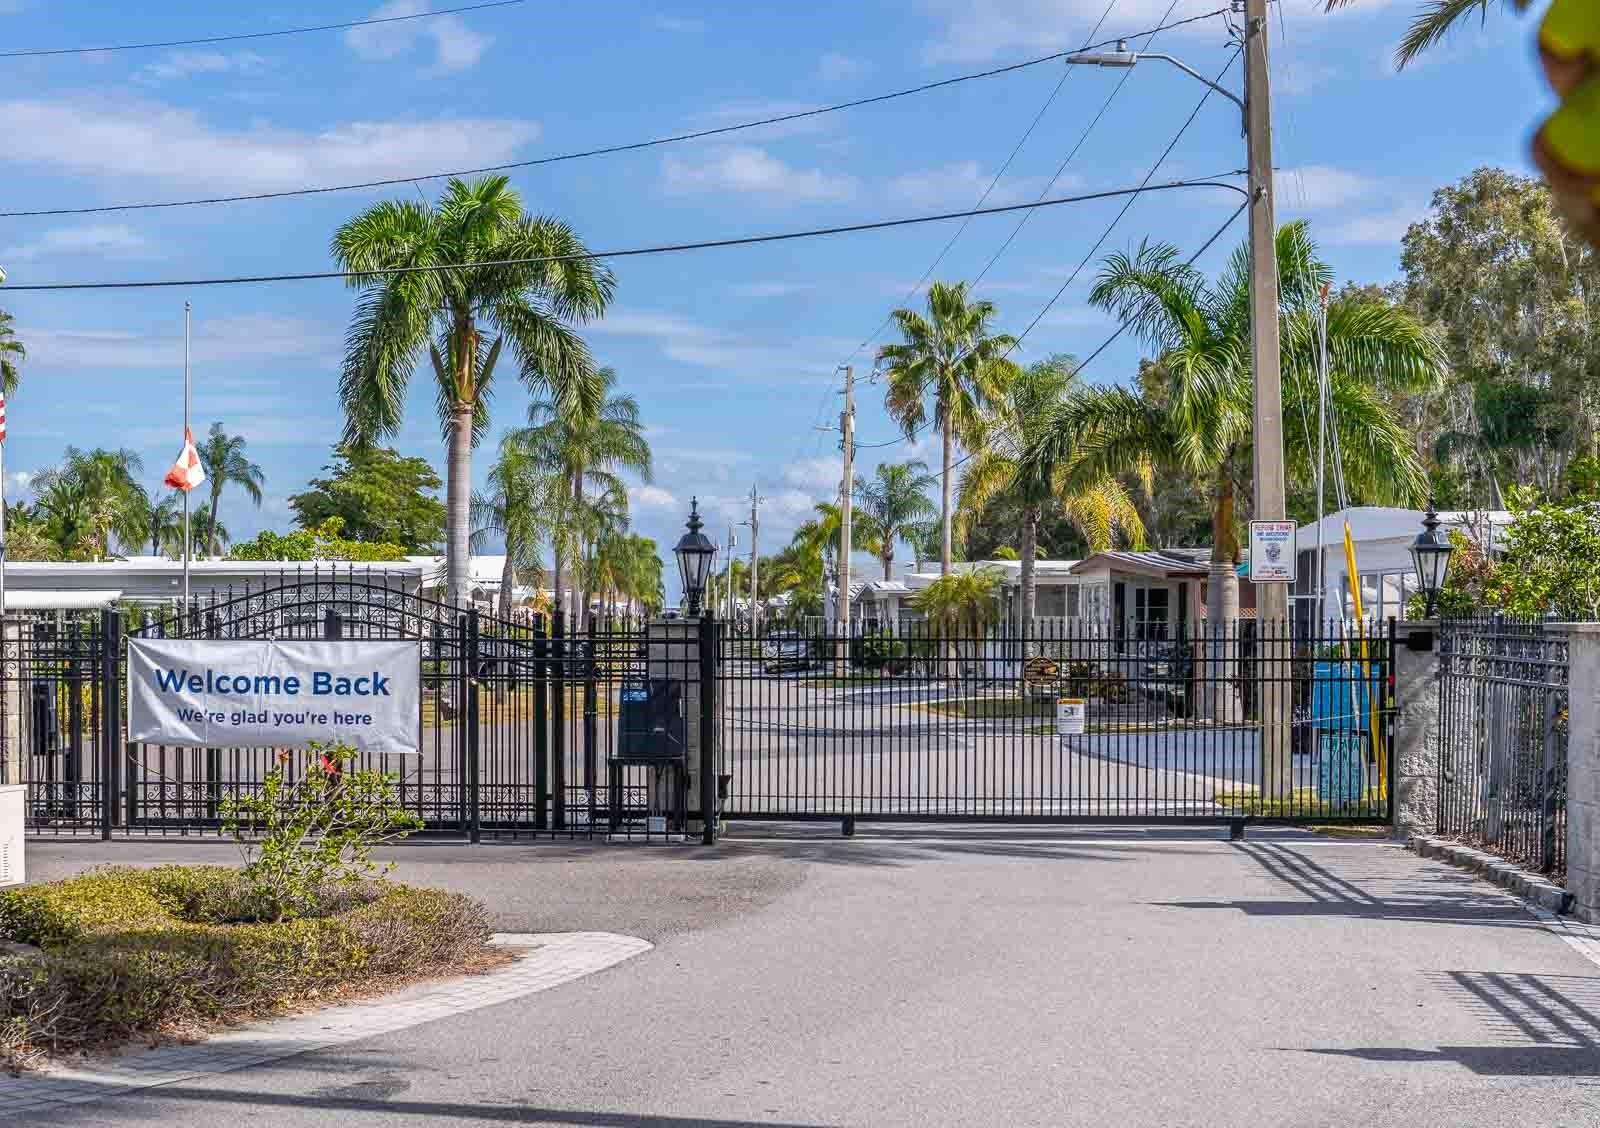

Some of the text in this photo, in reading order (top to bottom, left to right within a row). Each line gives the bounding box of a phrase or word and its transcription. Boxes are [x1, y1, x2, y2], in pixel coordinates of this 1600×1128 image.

[154, 669, 391, 696] Welcome Back
[177, 708, 372, 727] We're glad you're here
